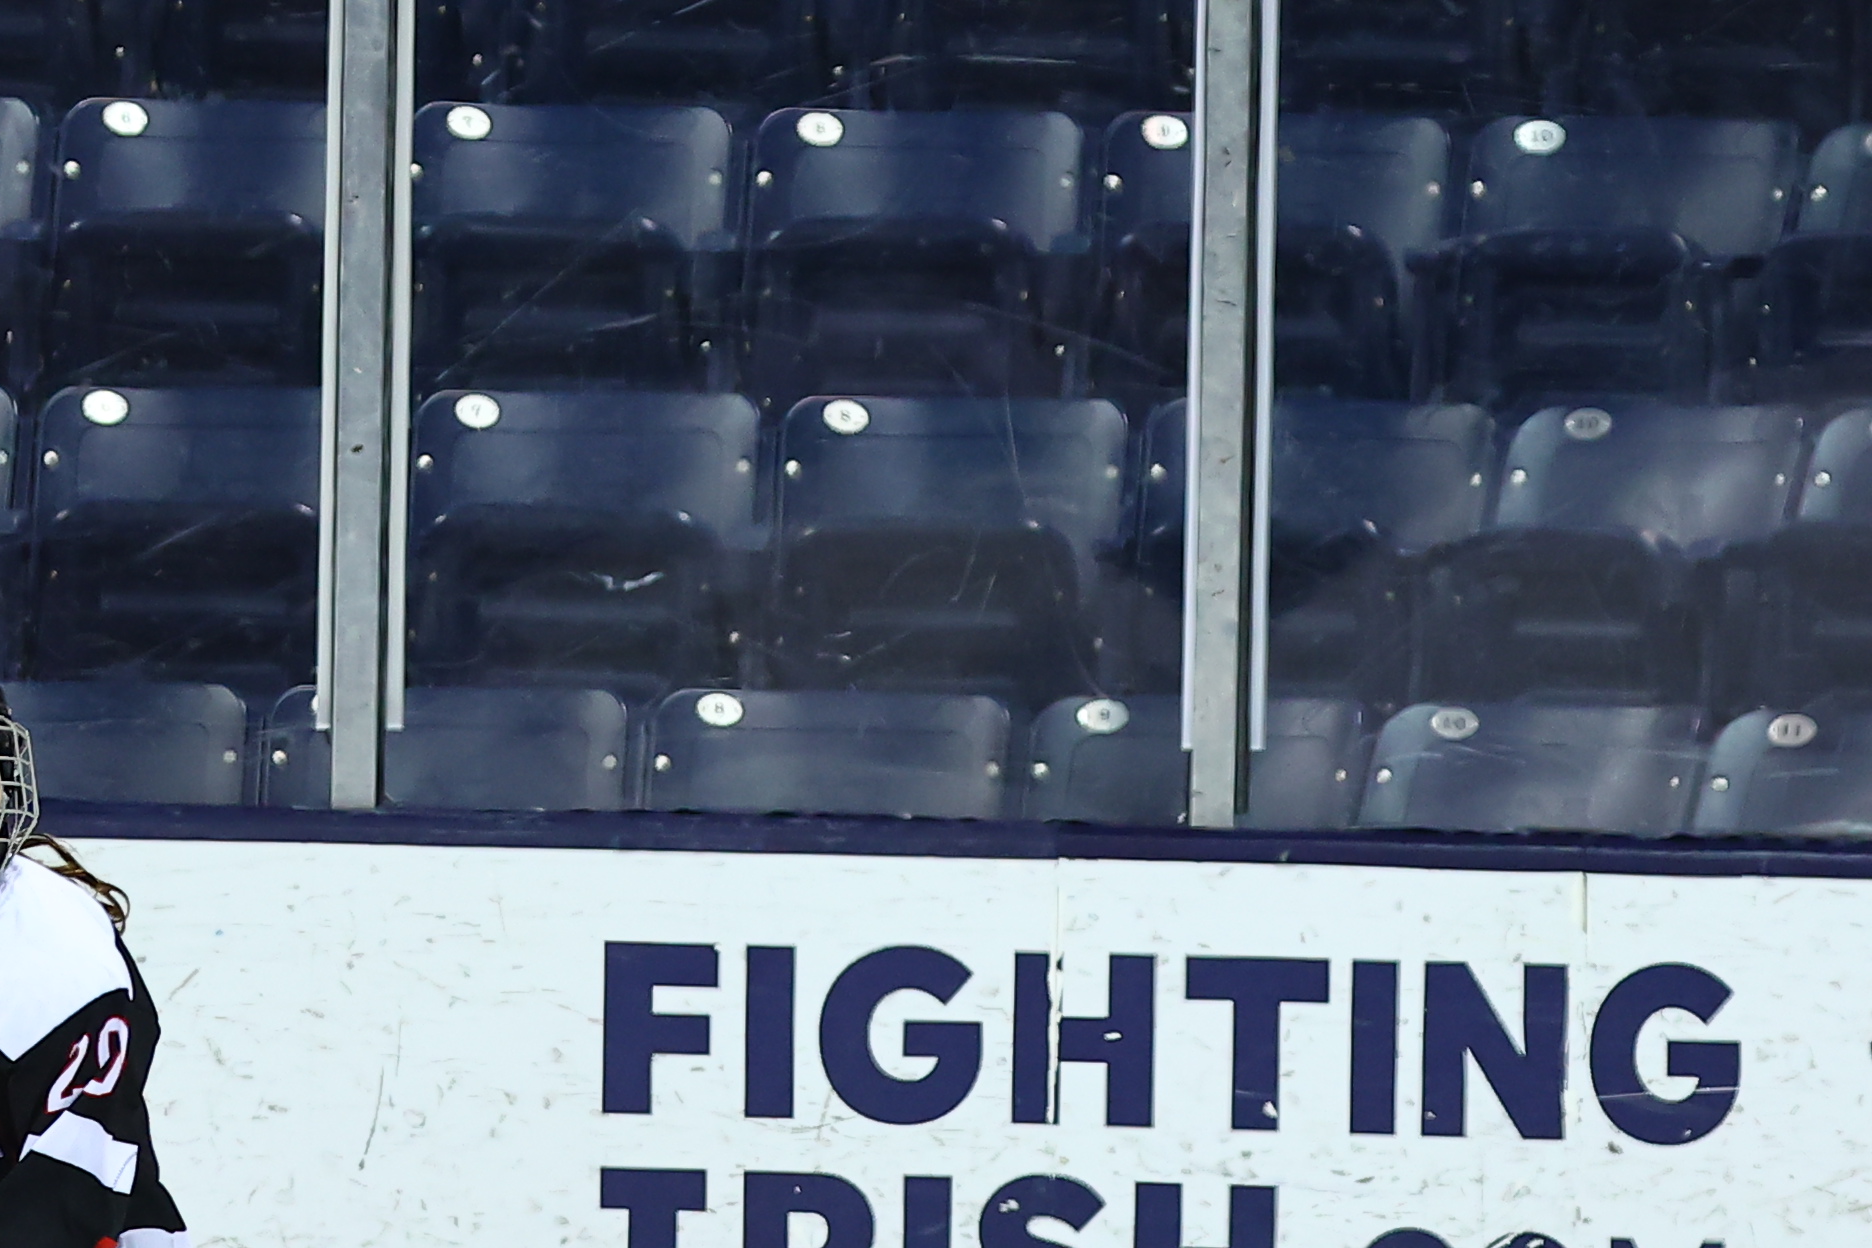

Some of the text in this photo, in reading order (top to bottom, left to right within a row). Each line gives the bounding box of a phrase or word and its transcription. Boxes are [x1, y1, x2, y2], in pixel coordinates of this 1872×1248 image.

[1530, 129, 1554, 142] 10
[45, 1014, 131, 1114] 29
[601, 940, 1742, 1146] FIGHTING
